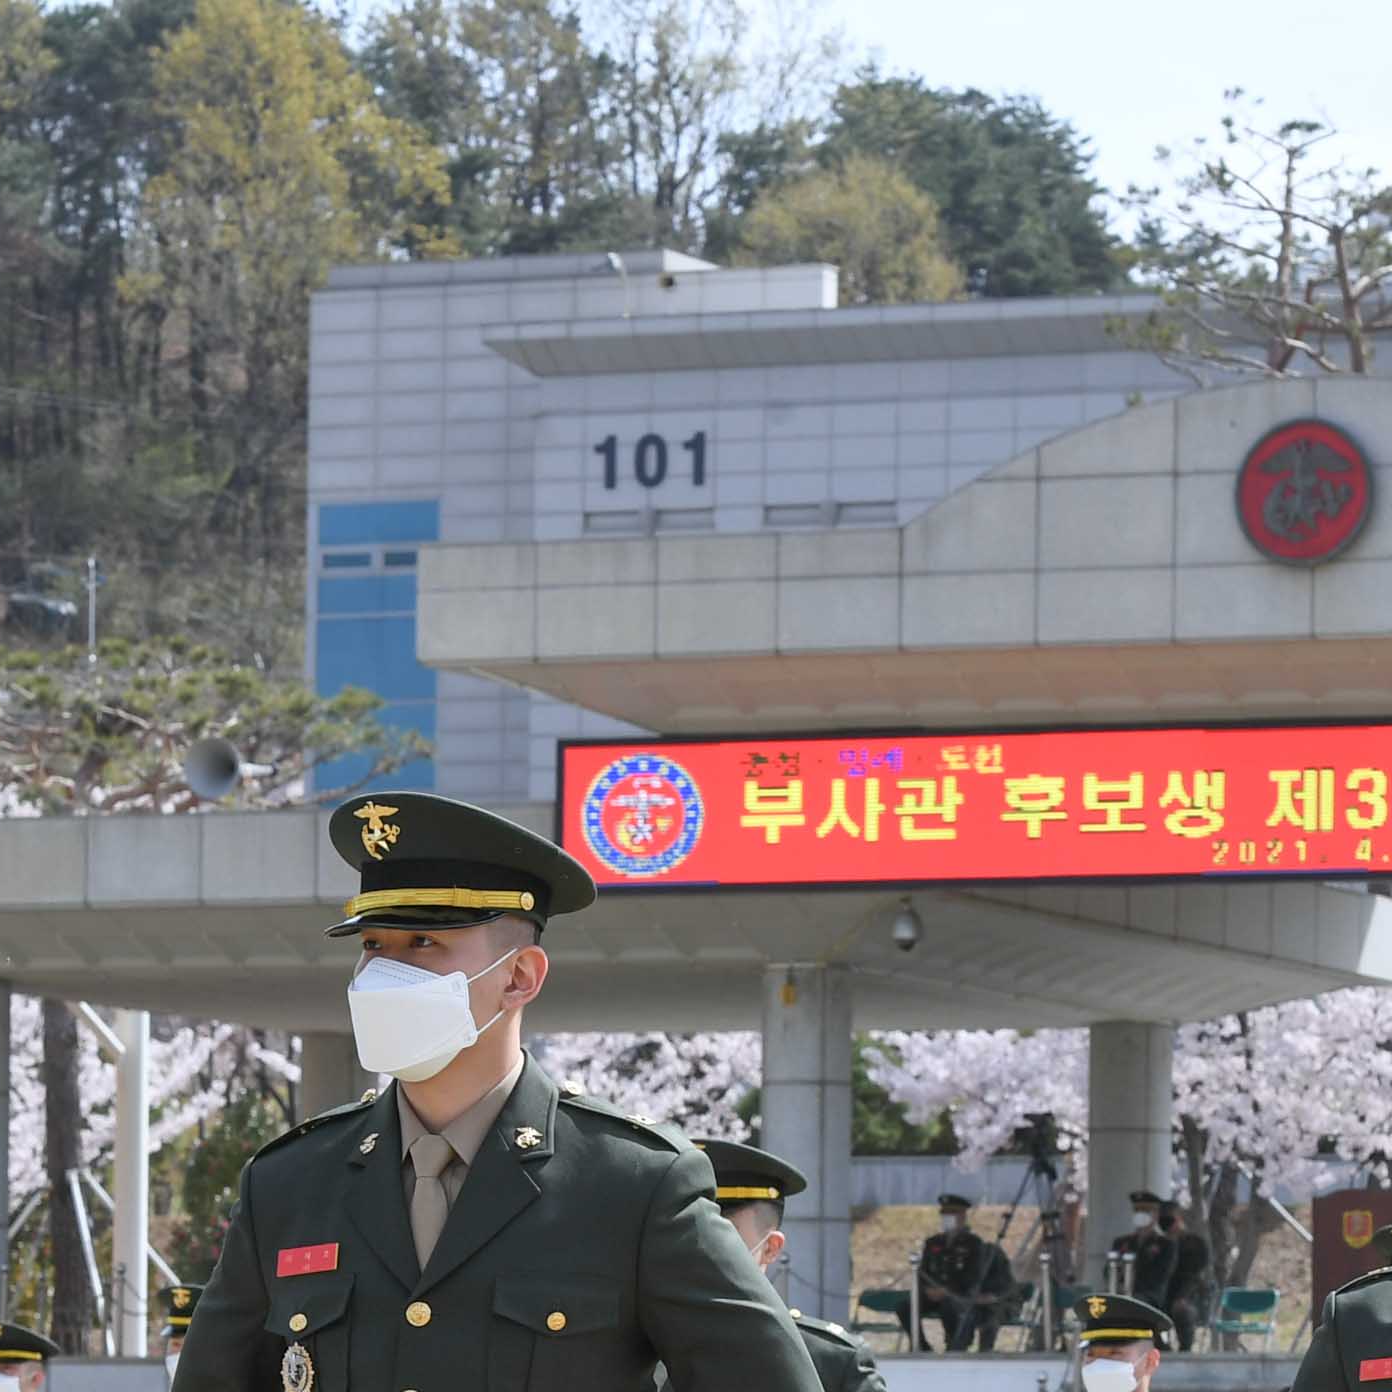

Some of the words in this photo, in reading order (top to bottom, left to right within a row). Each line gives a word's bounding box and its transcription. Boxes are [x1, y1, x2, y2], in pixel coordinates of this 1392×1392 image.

[592, 430, 708, 491] 101
[739, 775, 964, 844] 부사관
[1003, 769, 1226, 839] 후보생
